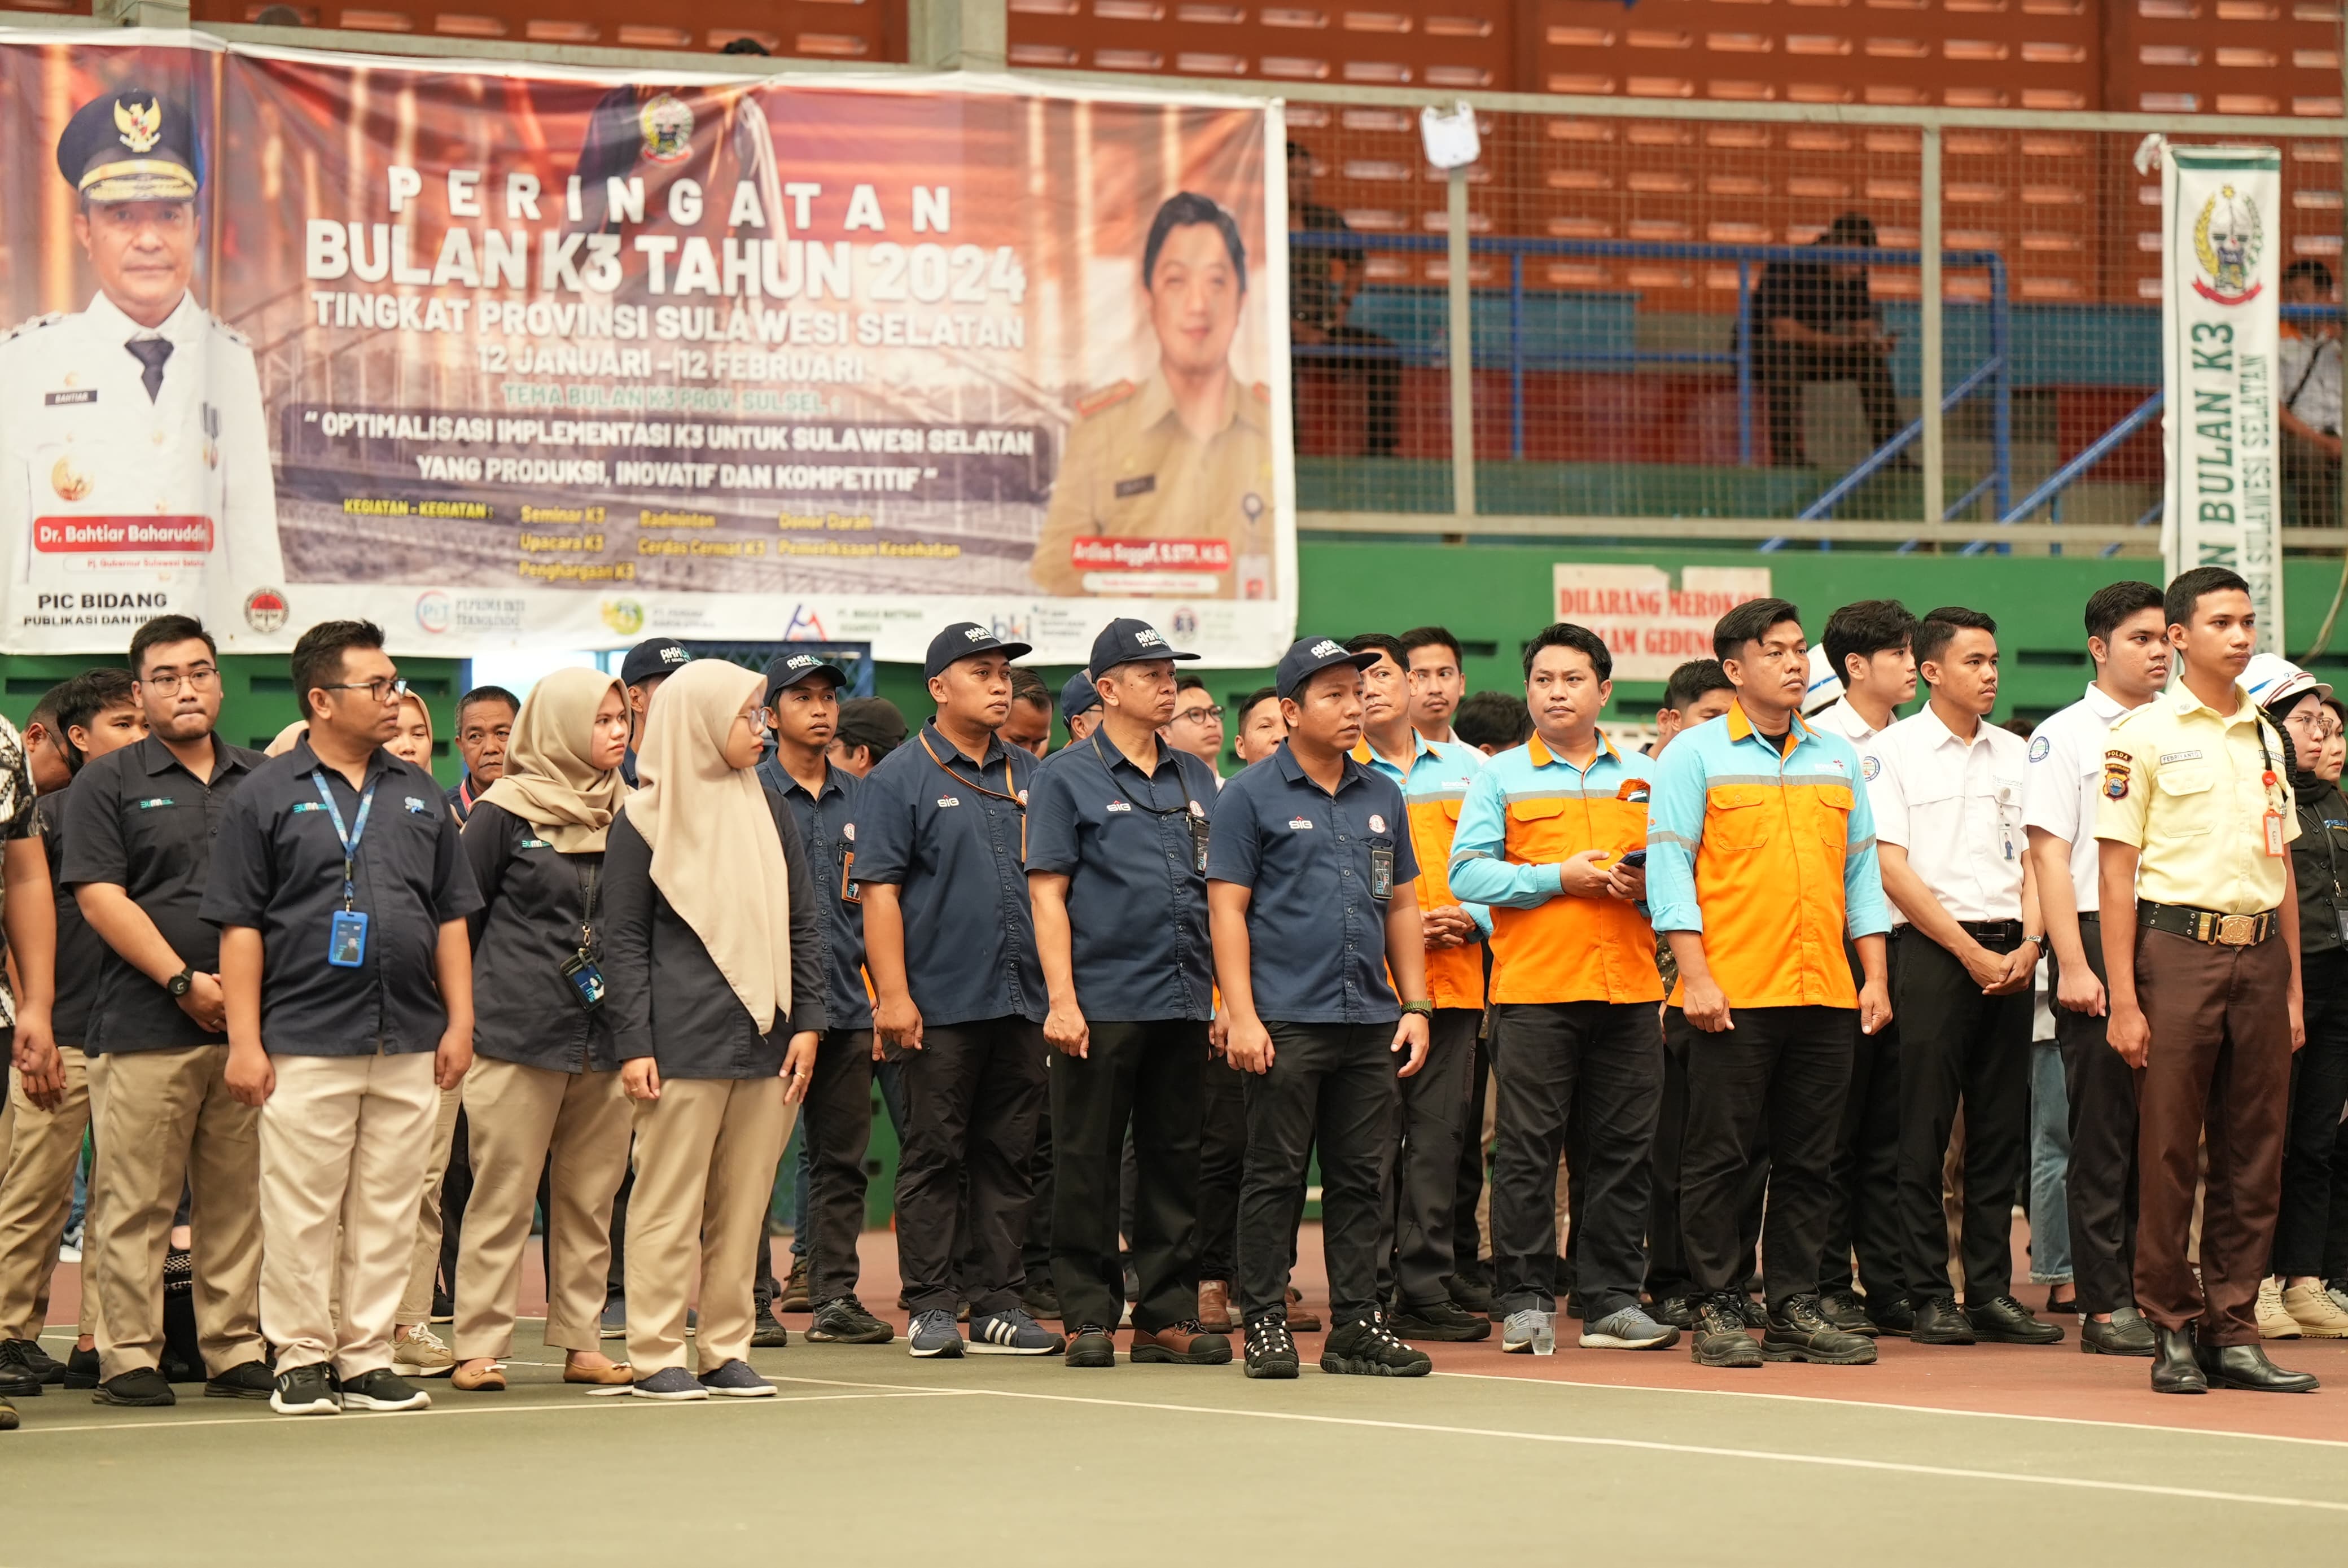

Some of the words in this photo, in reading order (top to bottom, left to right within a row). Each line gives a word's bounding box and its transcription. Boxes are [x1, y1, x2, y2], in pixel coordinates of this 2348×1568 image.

[388, 165, 951, 233] PERINGATAN
[305, 219, 528, 289] BULAN
[542, 231, 623, 294] K3
[634, 235, 852, 300] TAHUN
[868, 242, 1027, 304] 2024
[310, 291, 470, 334] TINGKAT
[479, 299, 648, 339] PROVINSI
[655, 305, 847, 345] SULAWESI
[857, 312, 1024, 349] SELATAN
[2191, 322, 2234, 373] K3
[477, 344, 508, 374] 12
[517, 346, 651, 378] JANUARI
[678, 349, 707, 379] 12
[713, 349, 863, 383] FEBRUARI
[503, 384, 562, 406] TEMA
[569, 386, 643, 408] BULAN
[649, 387, 675, 409] K3
[2240, 354, 2270, 447] SELATAN
[321, 411, 493, 443] OPTIMALISASI
[497, 419, 670, 448] IMPLEMENTASI
[674, 424, 705, 449] K3
[707, 425, 789, 450] UNTUK
[792, 427, 925, 453] SULAWESI
[927, 429, 1034, 456] SELATAN
[2194, 389, 2236, 525] BULAN
[416, 455, 482, 480] YANG
[485, 457, 611, 487] PRODUKSI,
[616, 461, 717, 489] INOVATIF
[720, 463, 772, 489] DAN
[775, 465, 921, 491] KOMPETITIF
[521, 505, 582, 524] Seminar
[40, 525, 62, 543] Dr.
[65, 524, 125, 542] Bahtiar
[520, 532, 583, 554] Upacara
[38, 594, 74, 609] PIC
[81, 593, 168, 608] BIDANG
[1560, 587, 1662, 616] DILARANG
[24, 614, 97, 626] PUBLIKASI
[102, 614, 131, 625] DAN
[2107, 751, 2130, 761] POLDA
[2163, 752, 2200, 763] FEBRIYANTO
[937, 795, 959, 807] SIG
[1106, 800, 1131, 812] SIG
[1289, 816, 1313, 829] SIG
